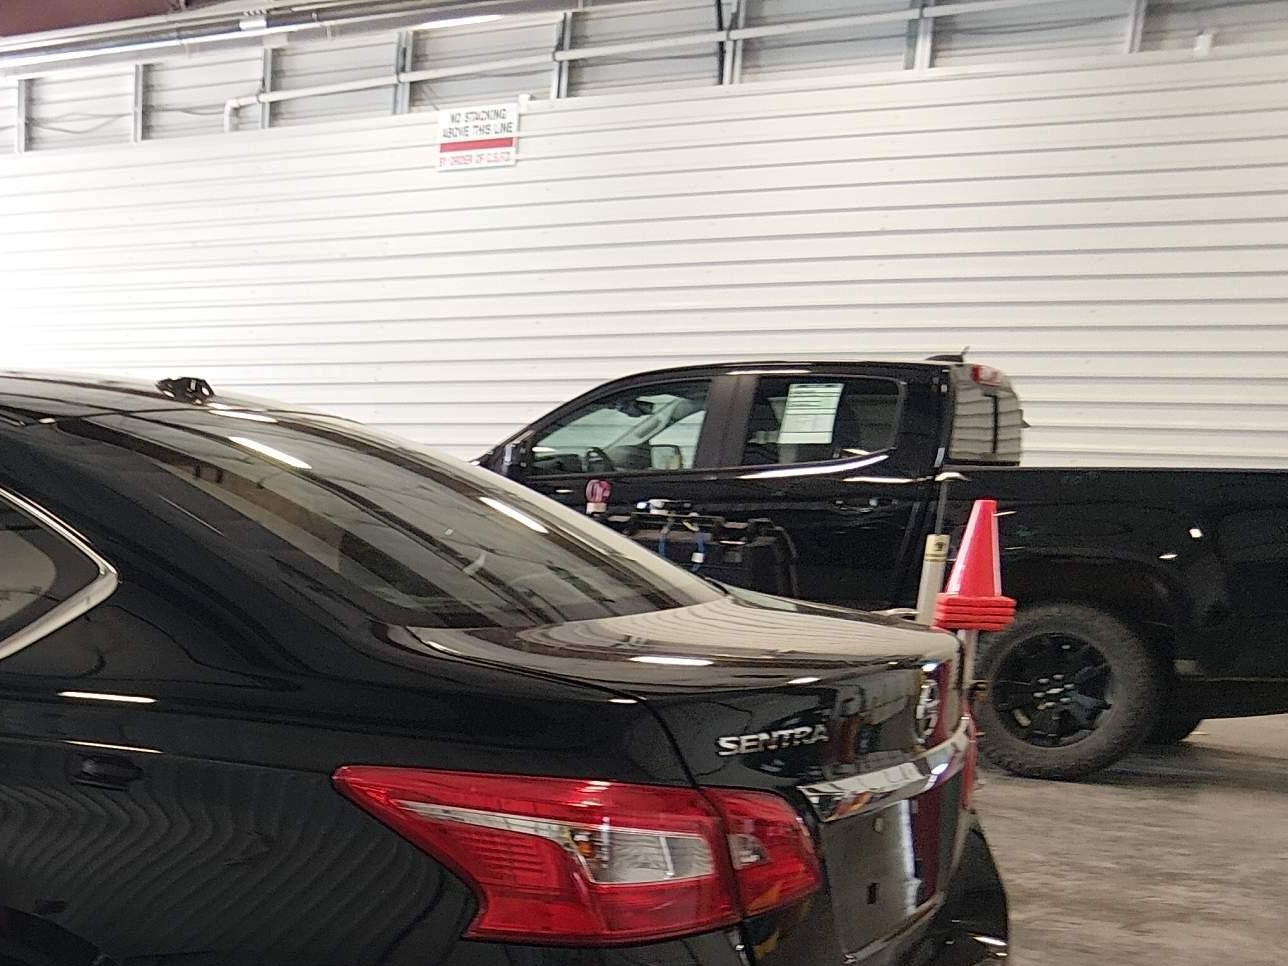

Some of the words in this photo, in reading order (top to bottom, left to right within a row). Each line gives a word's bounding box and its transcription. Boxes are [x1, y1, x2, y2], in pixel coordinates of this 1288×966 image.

[450, 112, 462, 124] NO
[464, 108, 507, 123] STACKING
[442, 125, 469, 138] ABOVE
[472, 123, 491, 136] THIS
[494, 122, 513, 135] LINE
[717, 723, 829, 757] SENTRA
